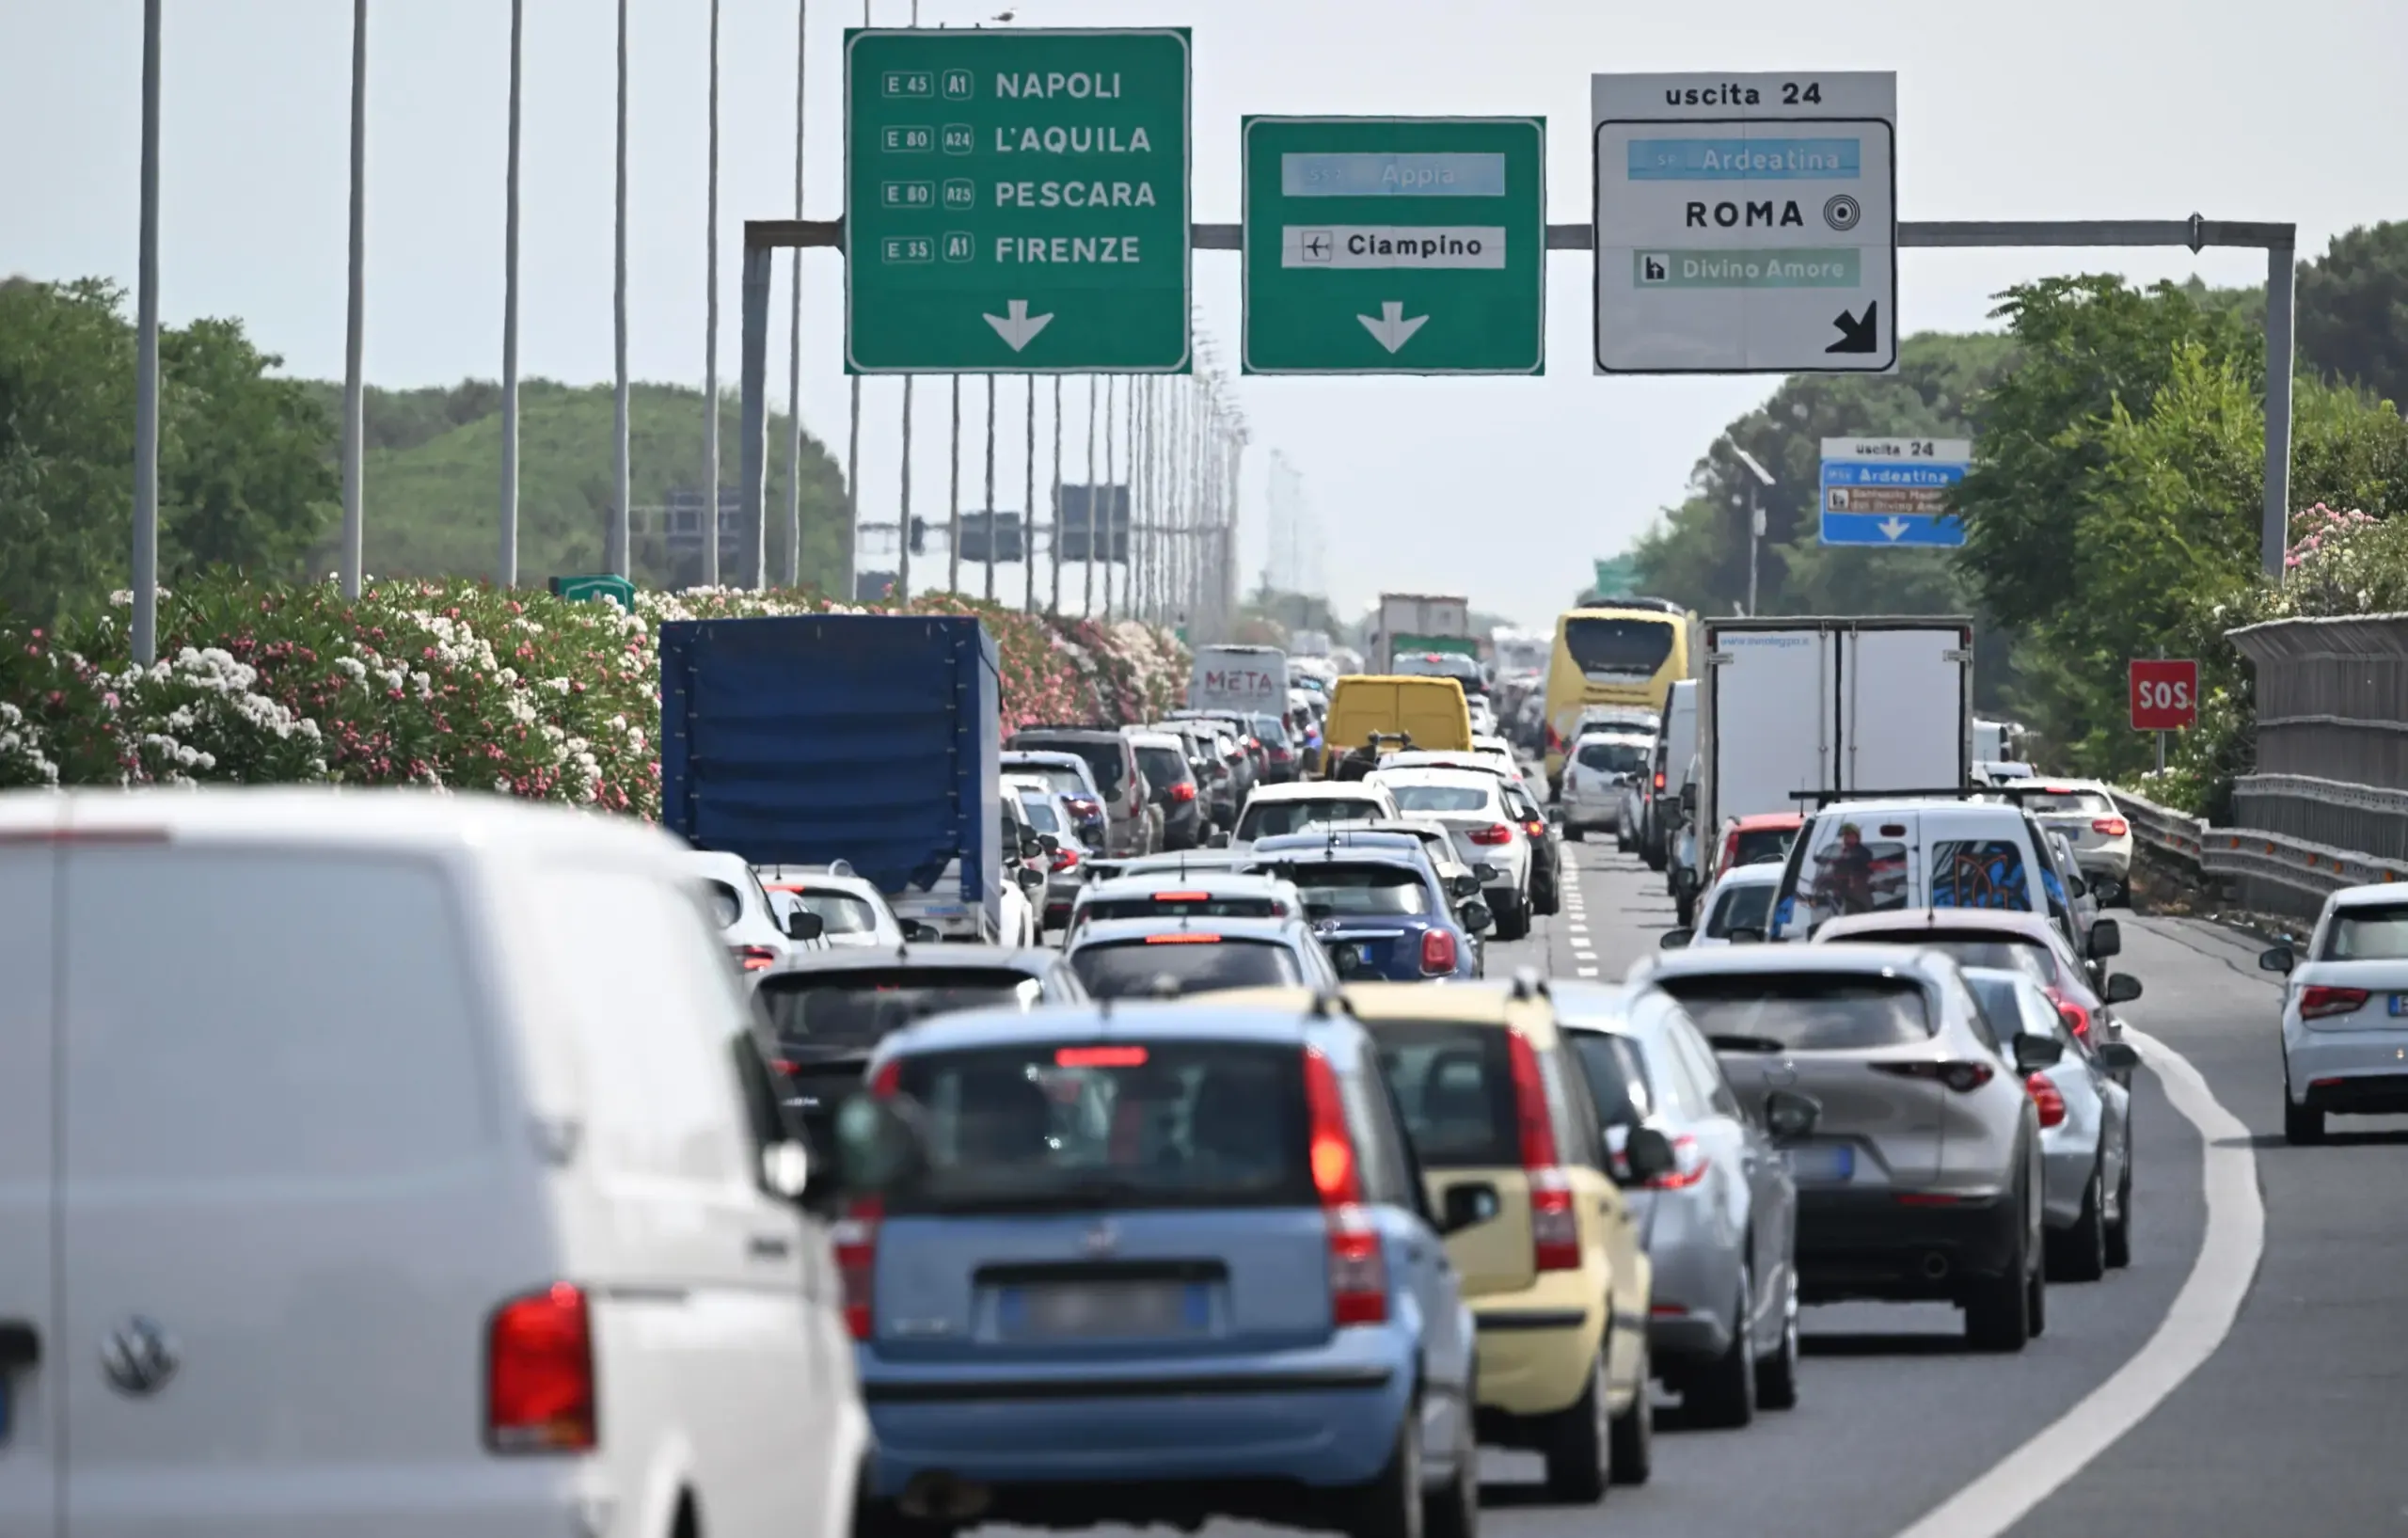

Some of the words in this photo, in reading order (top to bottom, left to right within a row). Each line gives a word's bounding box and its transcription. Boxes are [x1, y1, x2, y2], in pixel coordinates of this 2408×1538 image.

[888, 76, 899, 92] E
[908, 76, 927, 92] 45
[948, 75, 966, 93] A1
[995, 72, 1121, 99] NAPOLI
[1666, 83, 1760, 105] uscita
[1782, 83, 1822, 104] 24
[888, 131, 899, 147] E
[907, 131, 928, 147] 80
[945, 133, 970, 147] A24
[995, 127, 1151, 153] L'AQUILA
[1703, 149, 1840, 170] Ardeatina
[1382, 164, 1455, 188] Appia
[888, 185, 899, 202] E
[947, 186, 972, 202] A25
[995, 182, 1156, 208] PESCARA
[1686, 200, 1804, 228] ROMA
[888, 242, 900, 258] E
[909, 241, 928, 258] 35
[949, 237, 968, 257] A1
[995, 237, 1141, 263] FIRENZE
[1347, 234, 1482, 258] Ciampino
[1683, 259, 1760, 278] Divino
[1766, 259, 1846, 278] Amore
[1856, 443, 1901, 456] uscita
[1910, 441, 1935, 457] 24
[1860, 468, 1949, 484] Ardeatina
[2139, 680, 2188, 709] SOS
